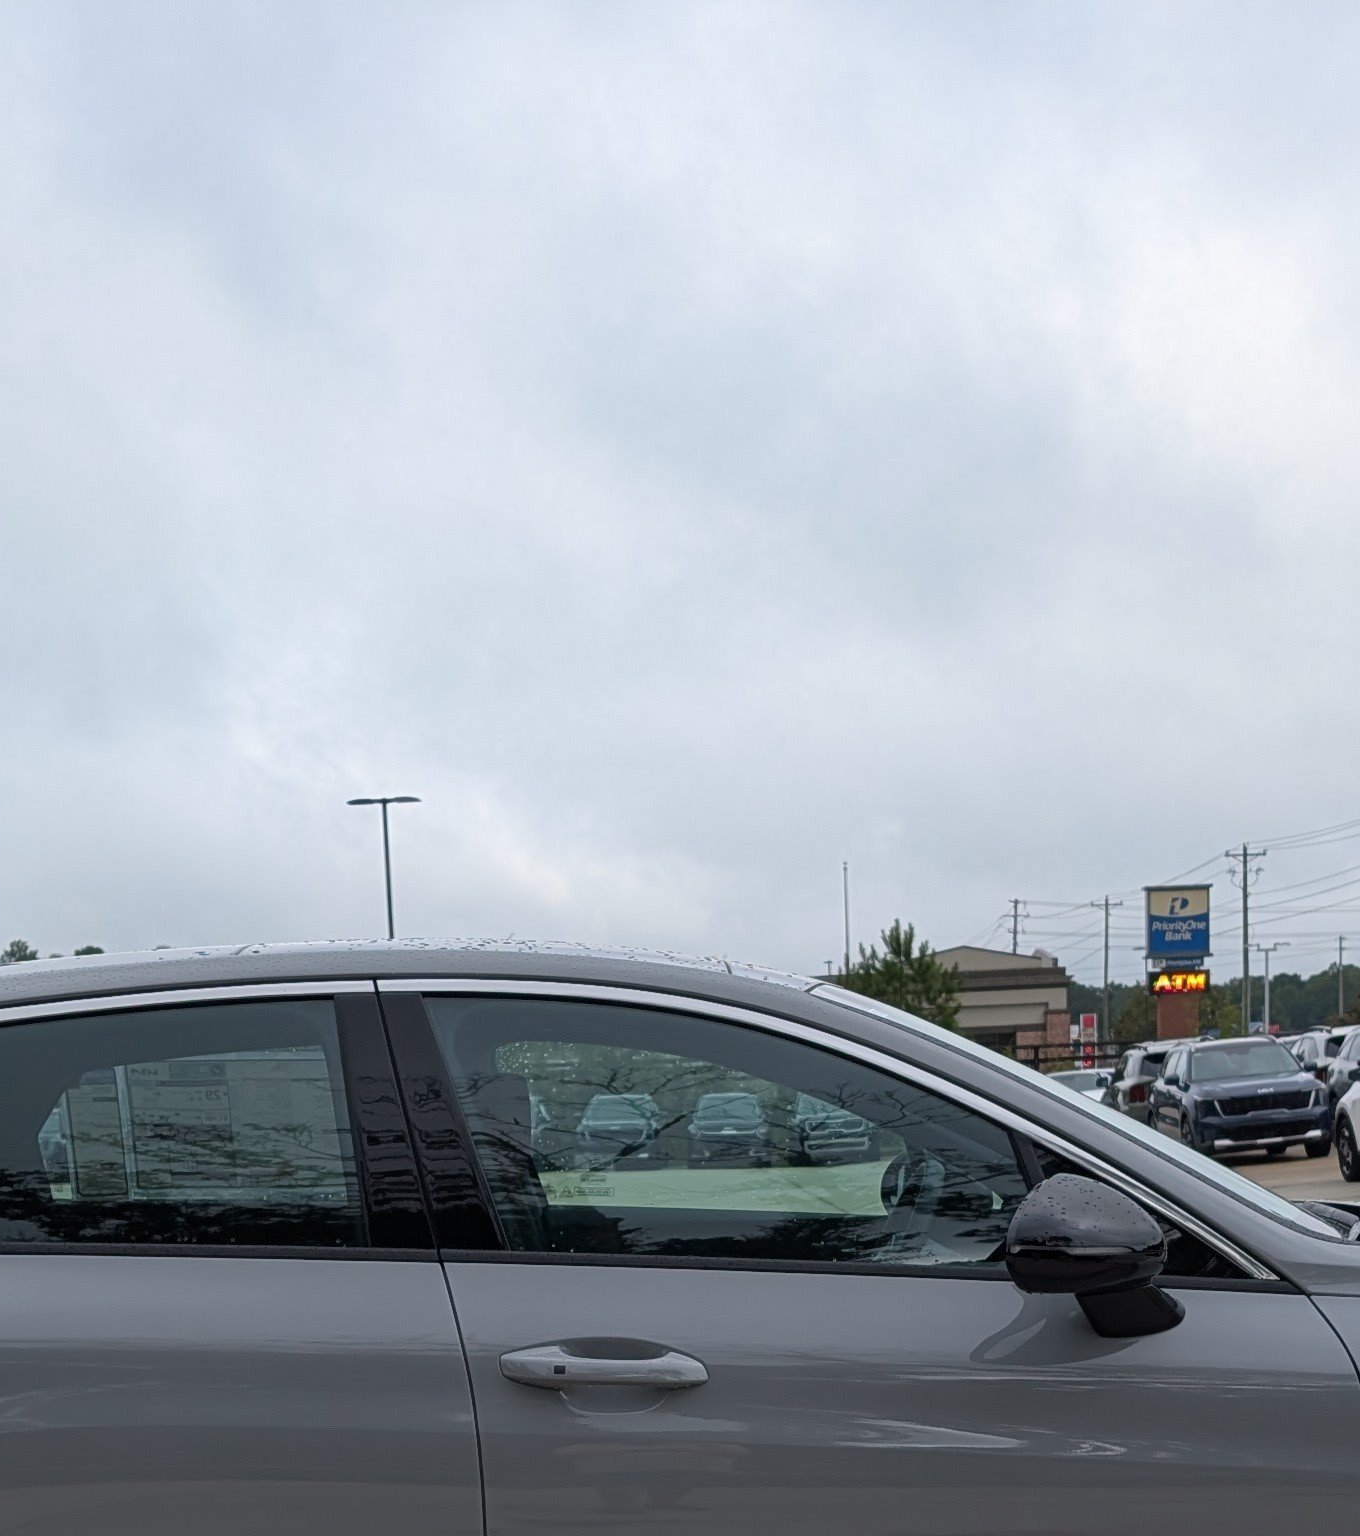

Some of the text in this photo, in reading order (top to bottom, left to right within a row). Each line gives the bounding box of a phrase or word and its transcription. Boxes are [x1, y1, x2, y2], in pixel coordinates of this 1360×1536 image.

[1152, 920, 1206, 932] PriorityOne
[1165, 931, 1191, 941] Bank
[1154, 973, 1207, 991] ATM
